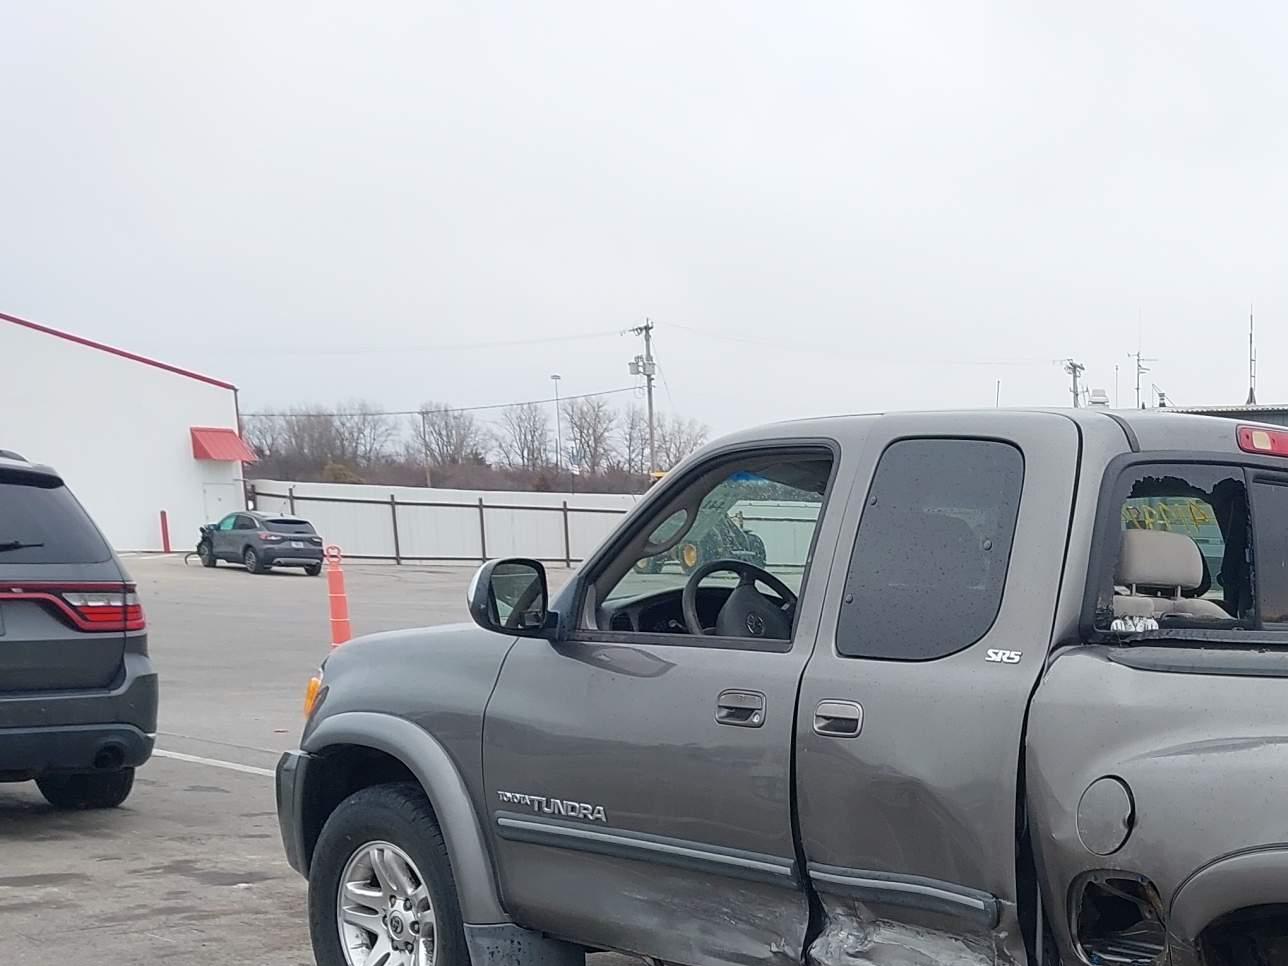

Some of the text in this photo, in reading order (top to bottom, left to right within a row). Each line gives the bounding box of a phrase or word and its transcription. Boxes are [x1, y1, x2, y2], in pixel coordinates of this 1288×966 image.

[984, 648, 1023, 664] SR5
[497, 790, 608, 823] TOYOTA TUNDRA
